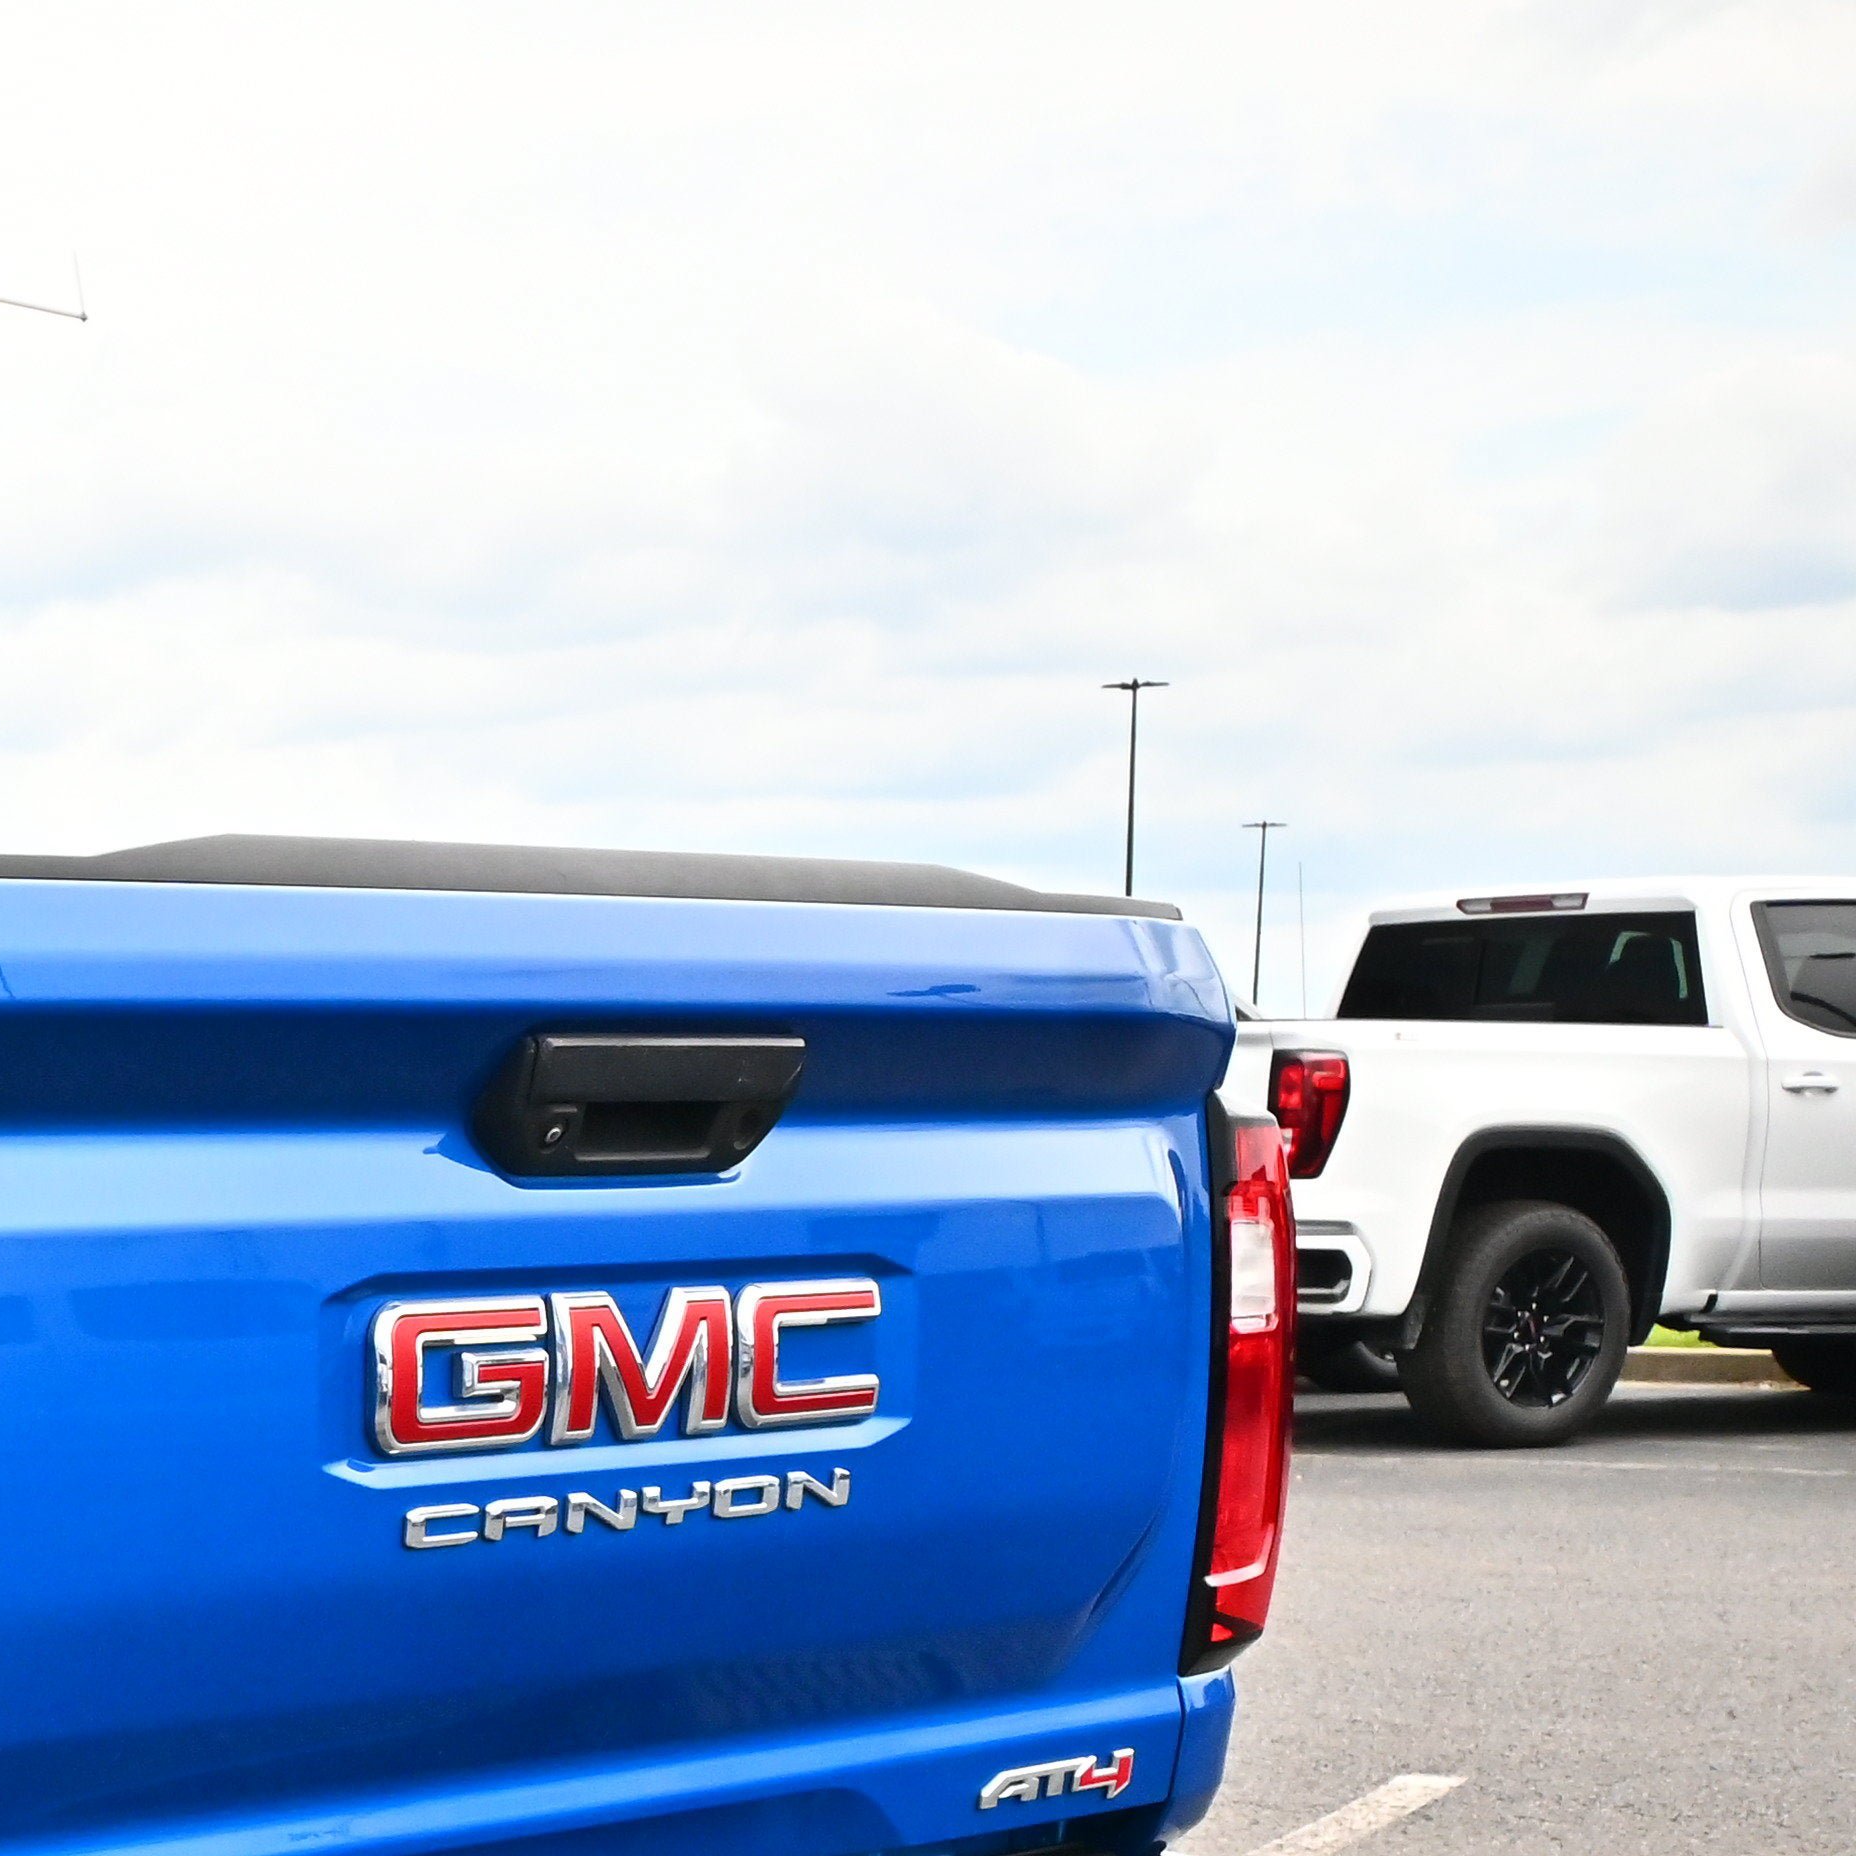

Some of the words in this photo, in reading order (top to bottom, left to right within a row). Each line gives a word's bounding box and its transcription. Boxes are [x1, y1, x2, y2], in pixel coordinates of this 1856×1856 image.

[373, 1276, 882, 1456] GMC
[403, 1466, 851, 1549] CANYON
[978, 1747, 1135, 1810] AT4
